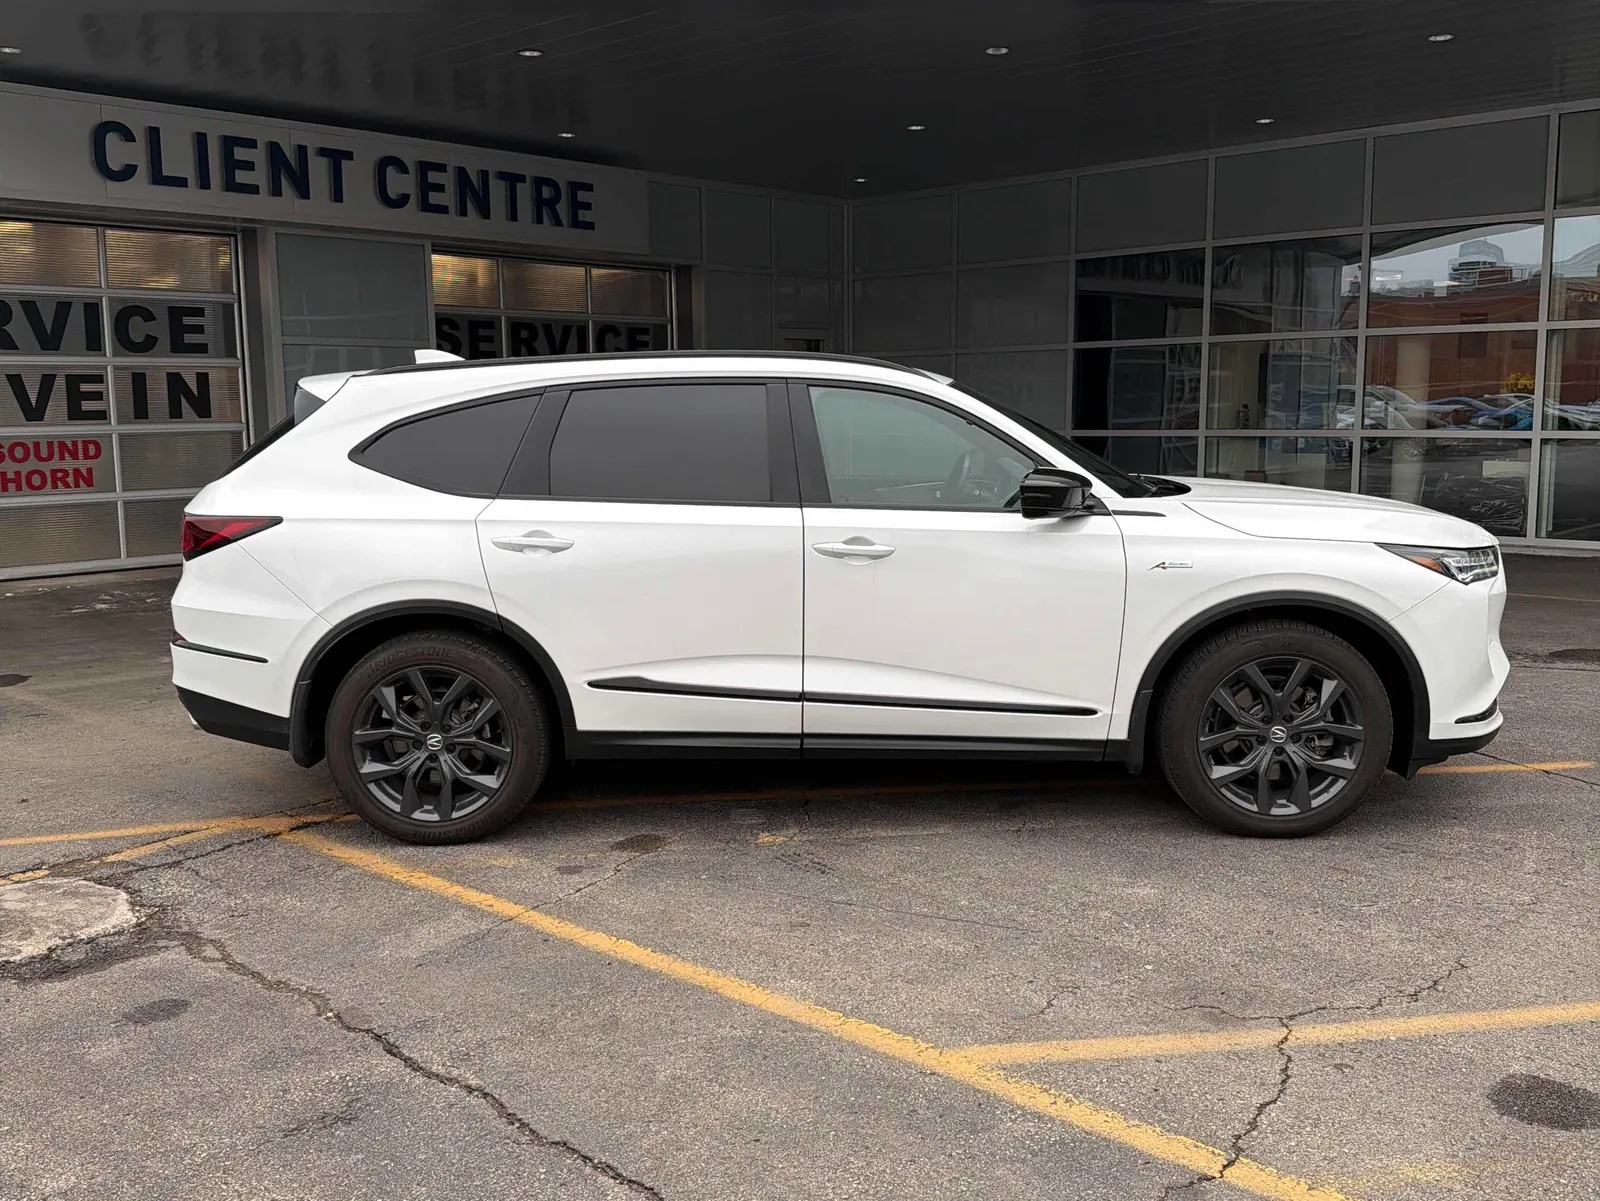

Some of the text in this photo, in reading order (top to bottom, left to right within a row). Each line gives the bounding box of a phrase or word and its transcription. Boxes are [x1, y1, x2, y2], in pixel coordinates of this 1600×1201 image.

[92, 120, 596, 231] CLIENT CENTRE
[435, 317, 651, 359] SERVICE
[0, 467, 94, 492] HORN
